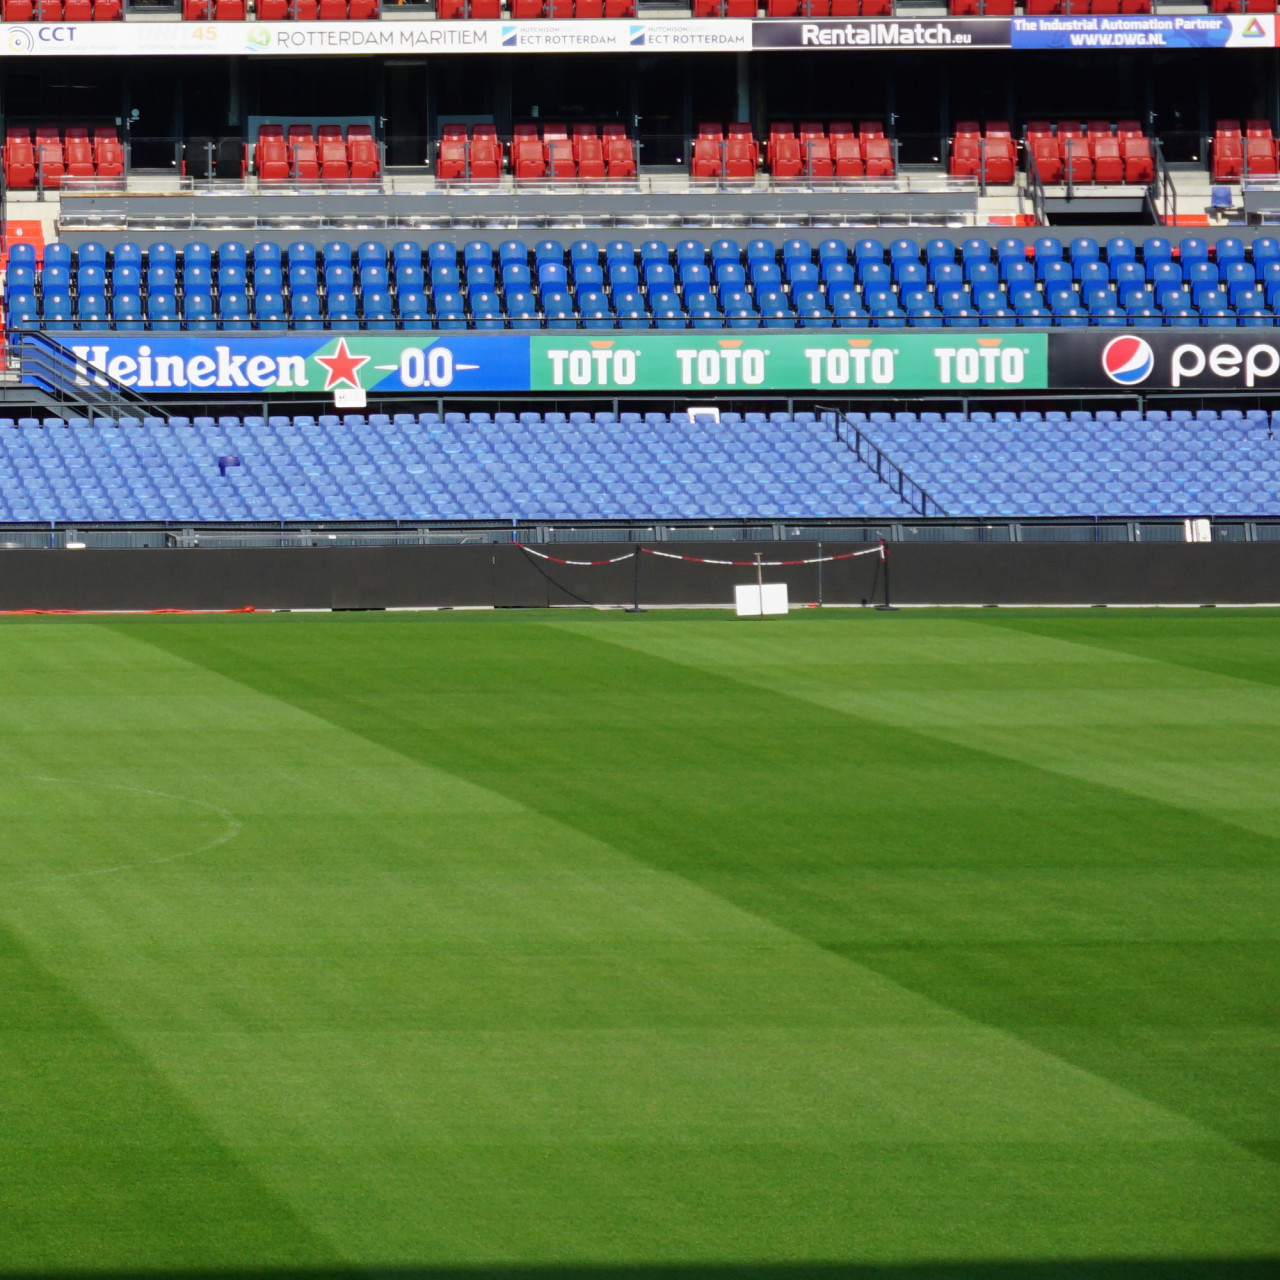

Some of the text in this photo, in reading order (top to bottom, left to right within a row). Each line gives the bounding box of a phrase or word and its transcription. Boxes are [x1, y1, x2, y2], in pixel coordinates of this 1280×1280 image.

[1014, 18, 1223, 31] The Industrial Automation Partner
[38, 26, 77, 42] CCT
[277, 31, 394, 47] ROTTERDAM
[400, 30, 487, 47] MARITIEM
[520, 35, 616, 45] ECT ROTTERDAM
[648, 34, 745, 44] ECT ROTTERDAM
[801, 23, 972, 45] RentalMatch.eu
[1070, 33, 1167, 46] WWW.DWG.NL
[72, 345, 454, 388] Heineken 0.0
